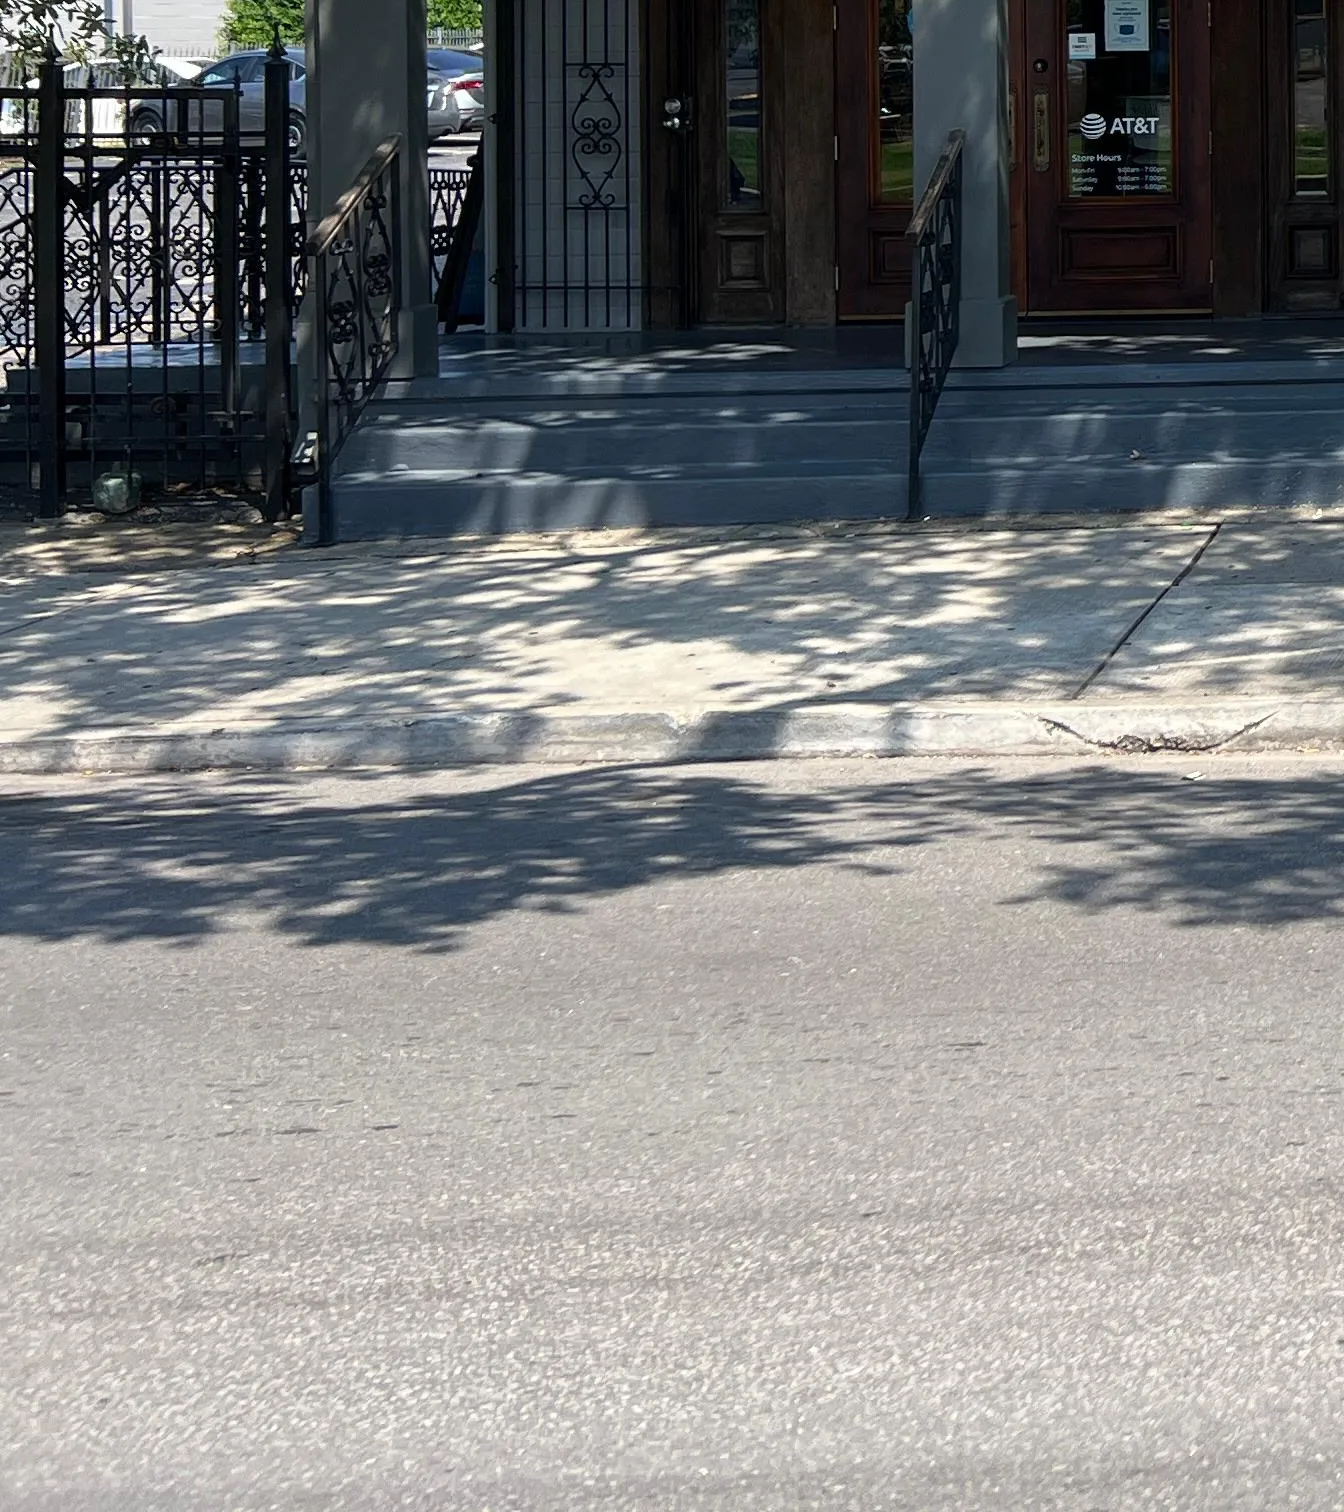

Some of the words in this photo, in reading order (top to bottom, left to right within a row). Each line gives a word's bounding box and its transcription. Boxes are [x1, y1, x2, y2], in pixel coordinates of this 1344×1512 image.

[1109, 117, 1160, 134] AT&T
[1071, 154, 1095, 163] Store
[1096, 154, 1122, 162] Hours
